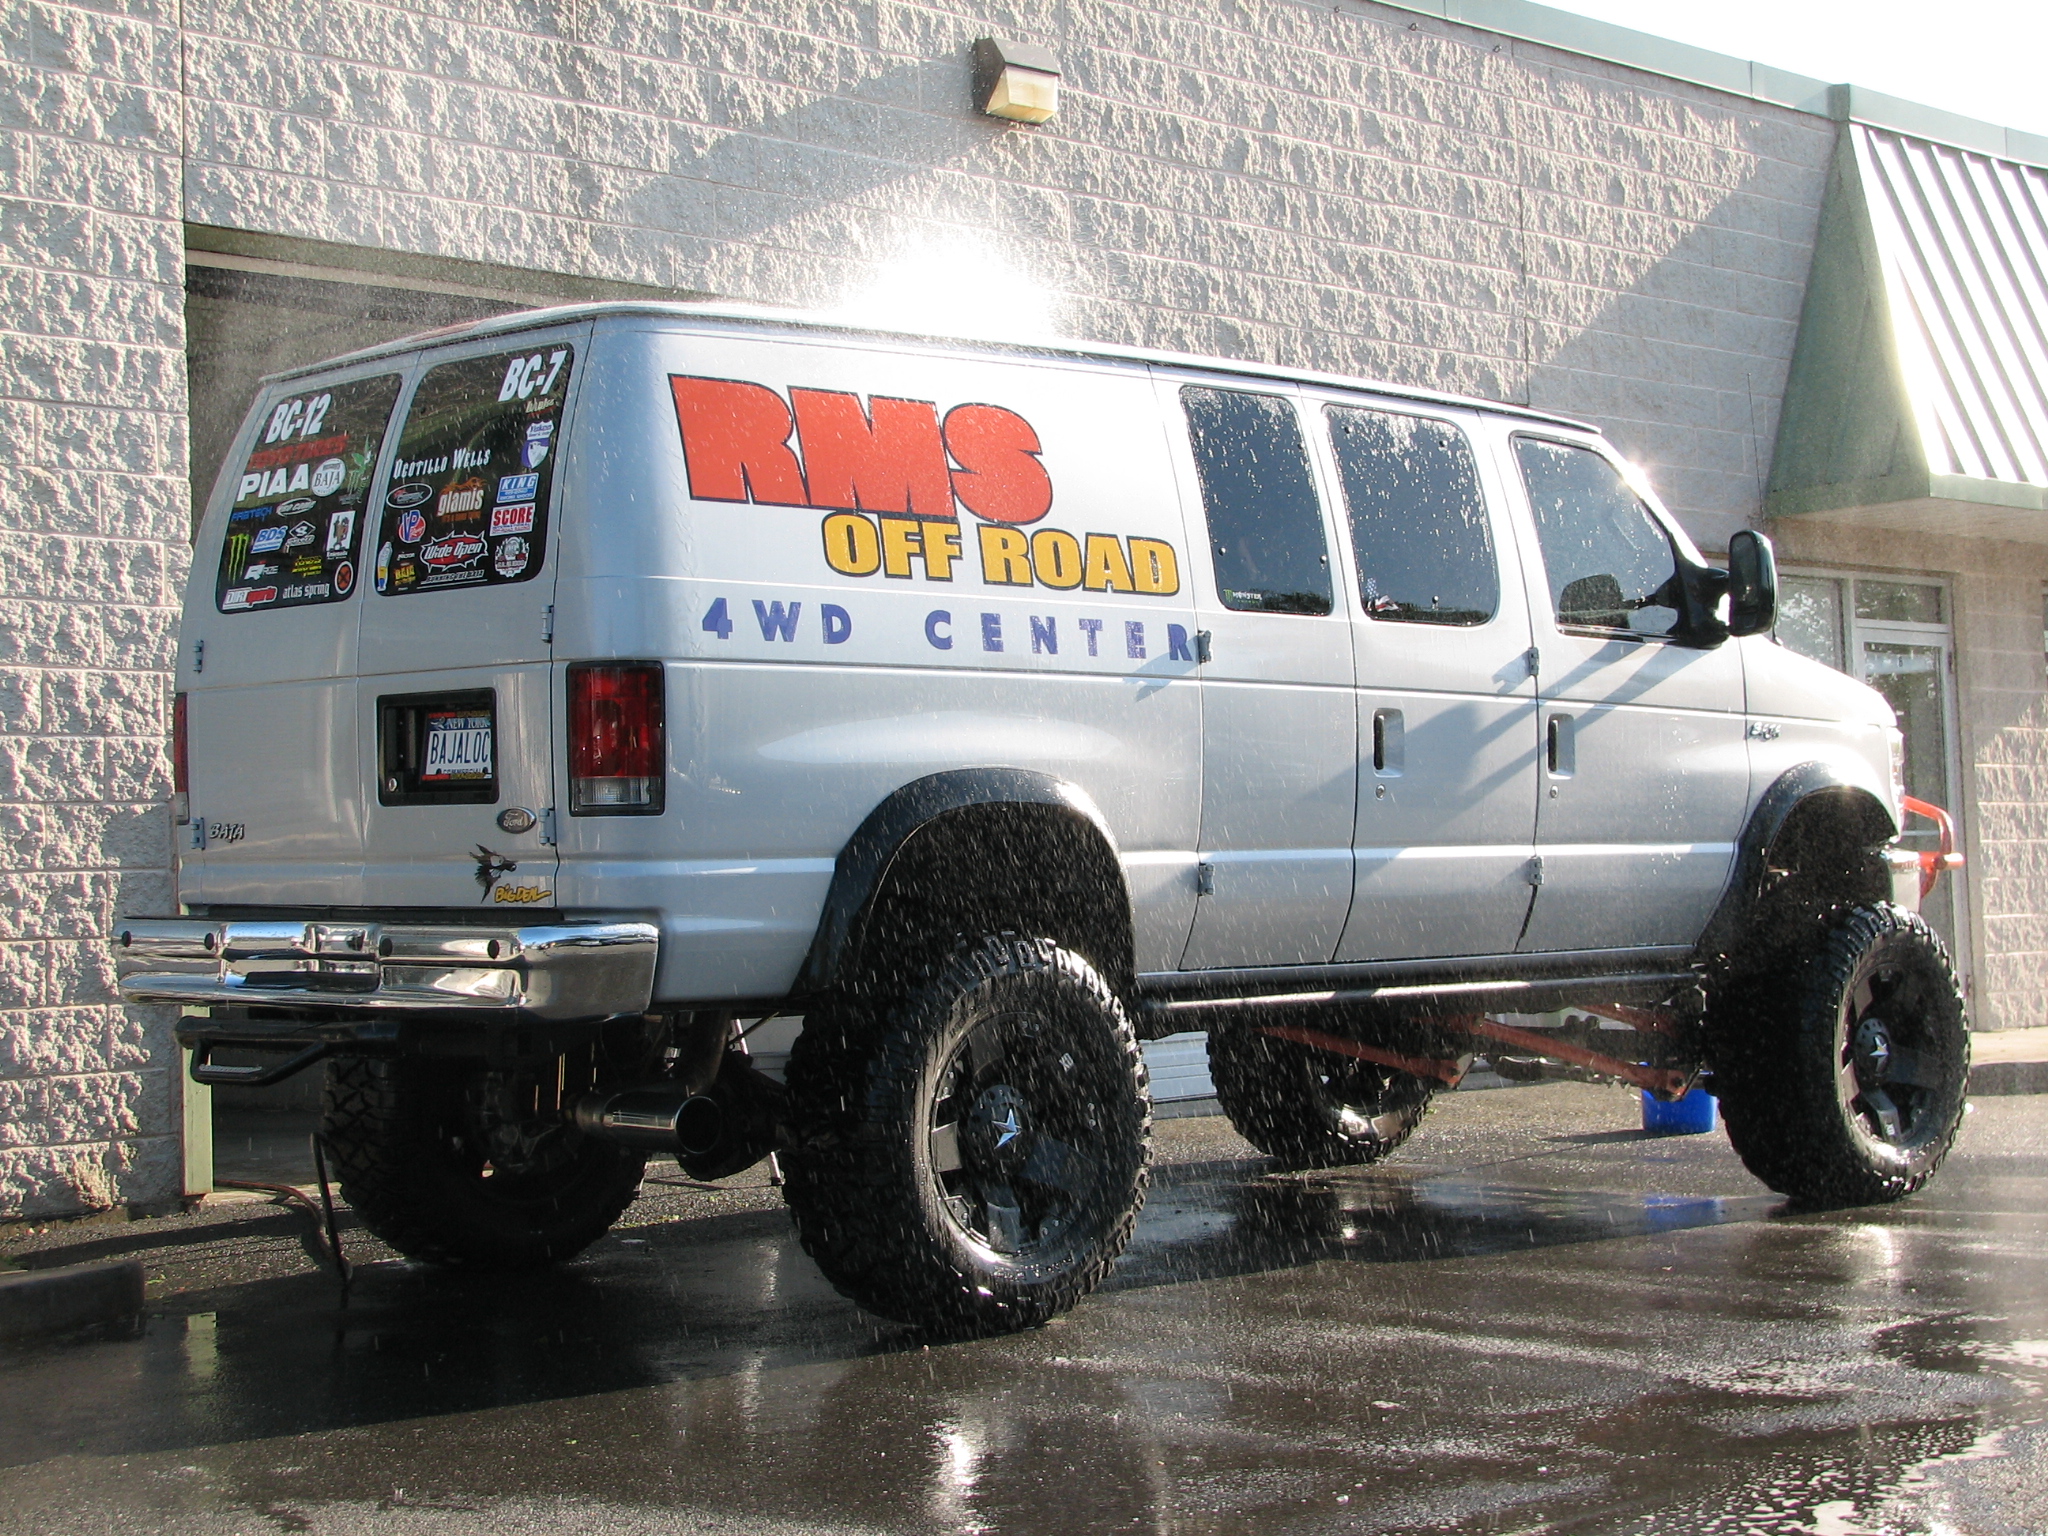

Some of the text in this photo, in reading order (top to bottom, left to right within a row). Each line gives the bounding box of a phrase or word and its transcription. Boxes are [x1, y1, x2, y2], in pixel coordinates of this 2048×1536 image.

[498, 350, 567, 402] BC-7
[264, 393, 332, 444] BC-12
[668, 373, 1053, 526] RMS
[236, 463, 310, 502] PIAA
[313, 471, 341, 489] BAJA
[501, 475, 537, 490] KING
[436, 487, 485, 516] glamis
[493, 506, 534, 526] SCORE
[256, 526, 288, 543] BDS
[424, 544, 451, 560] Wide
[453, 541, 483, 559] Open
[822, 510, 1181, 596] OFF ROAD
[282, 582, 330, 599] atlas spring
[701, 597, 1194, 662] 4WD CENTER
[444, 717, 465, 730] NEW
[430, 731, 490, 765] BAJALOC
[503, 811, 524, 828] Ford
